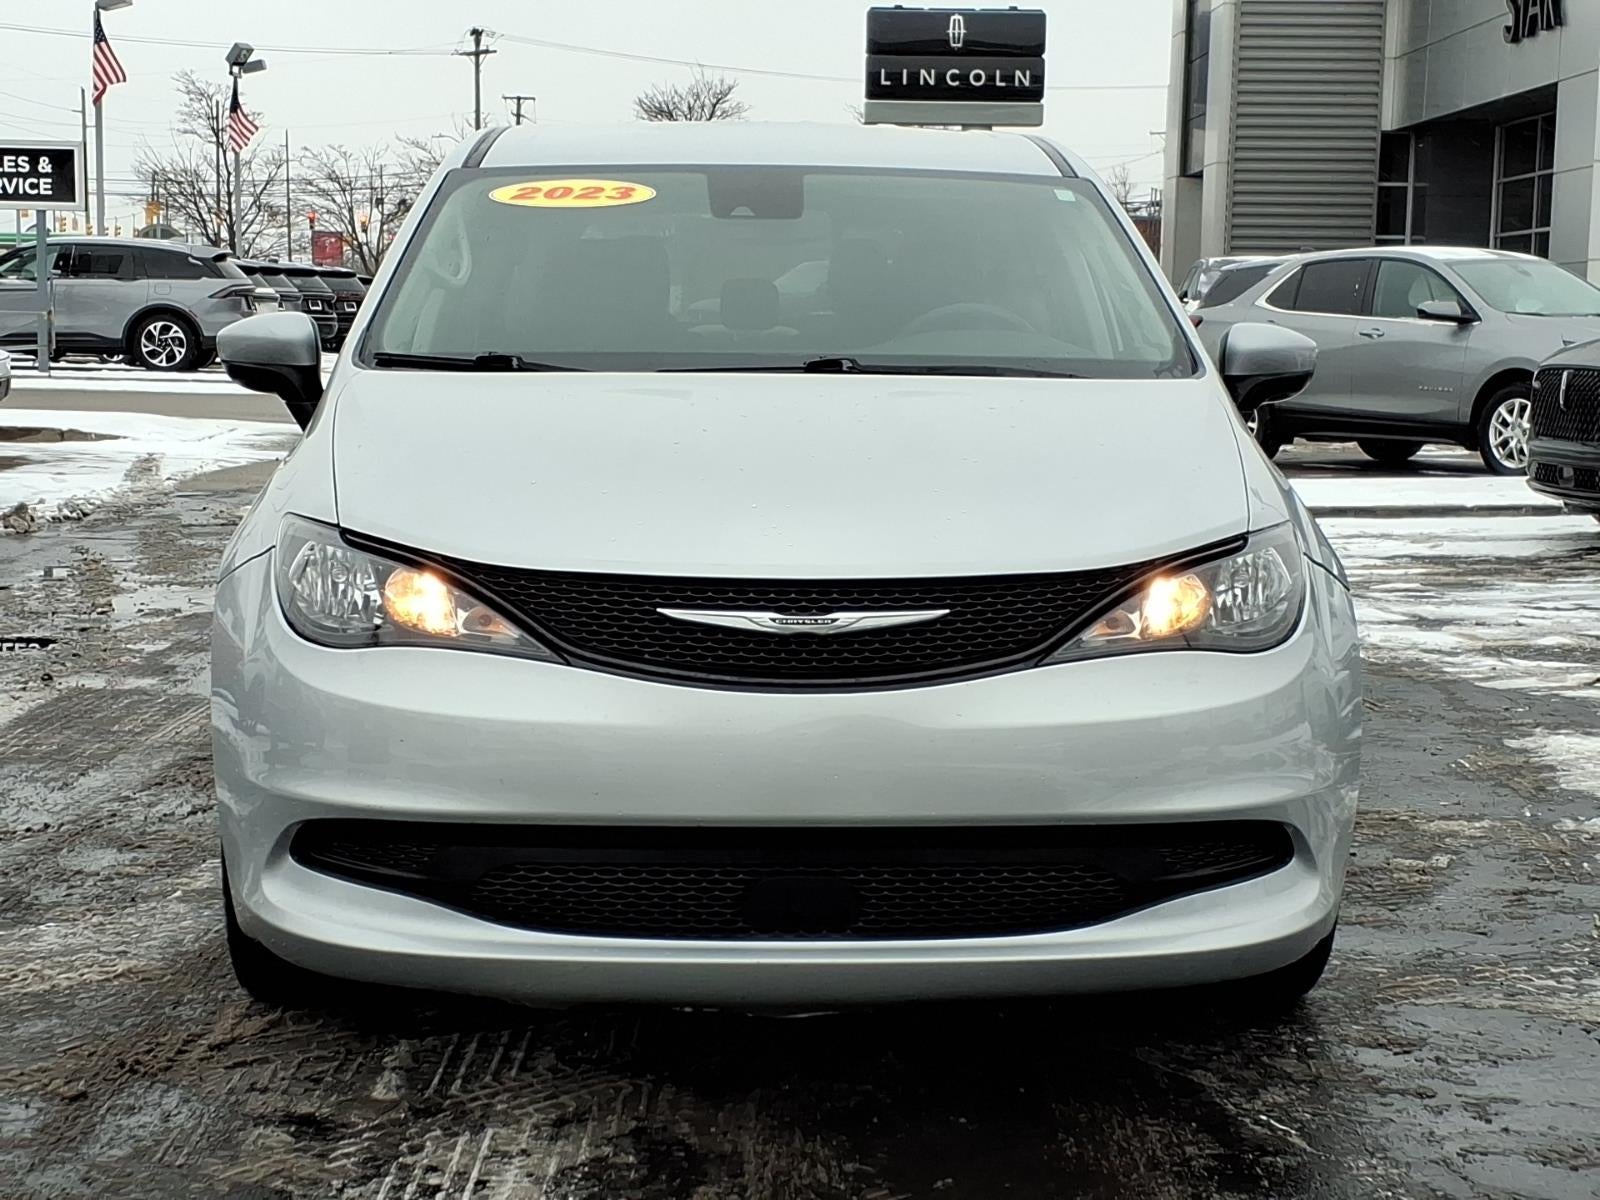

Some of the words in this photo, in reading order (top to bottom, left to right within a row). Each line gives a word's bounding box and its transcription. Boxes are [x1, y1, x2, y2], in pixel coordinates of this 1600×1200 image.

[880, 68, 1030, 87] LINCOLN
[0, 155, 30, 173] ES
[37, 156, 52, 173] &
[0, 177, 53, 195] VICE
[509, 186, 636, 200] 2023
